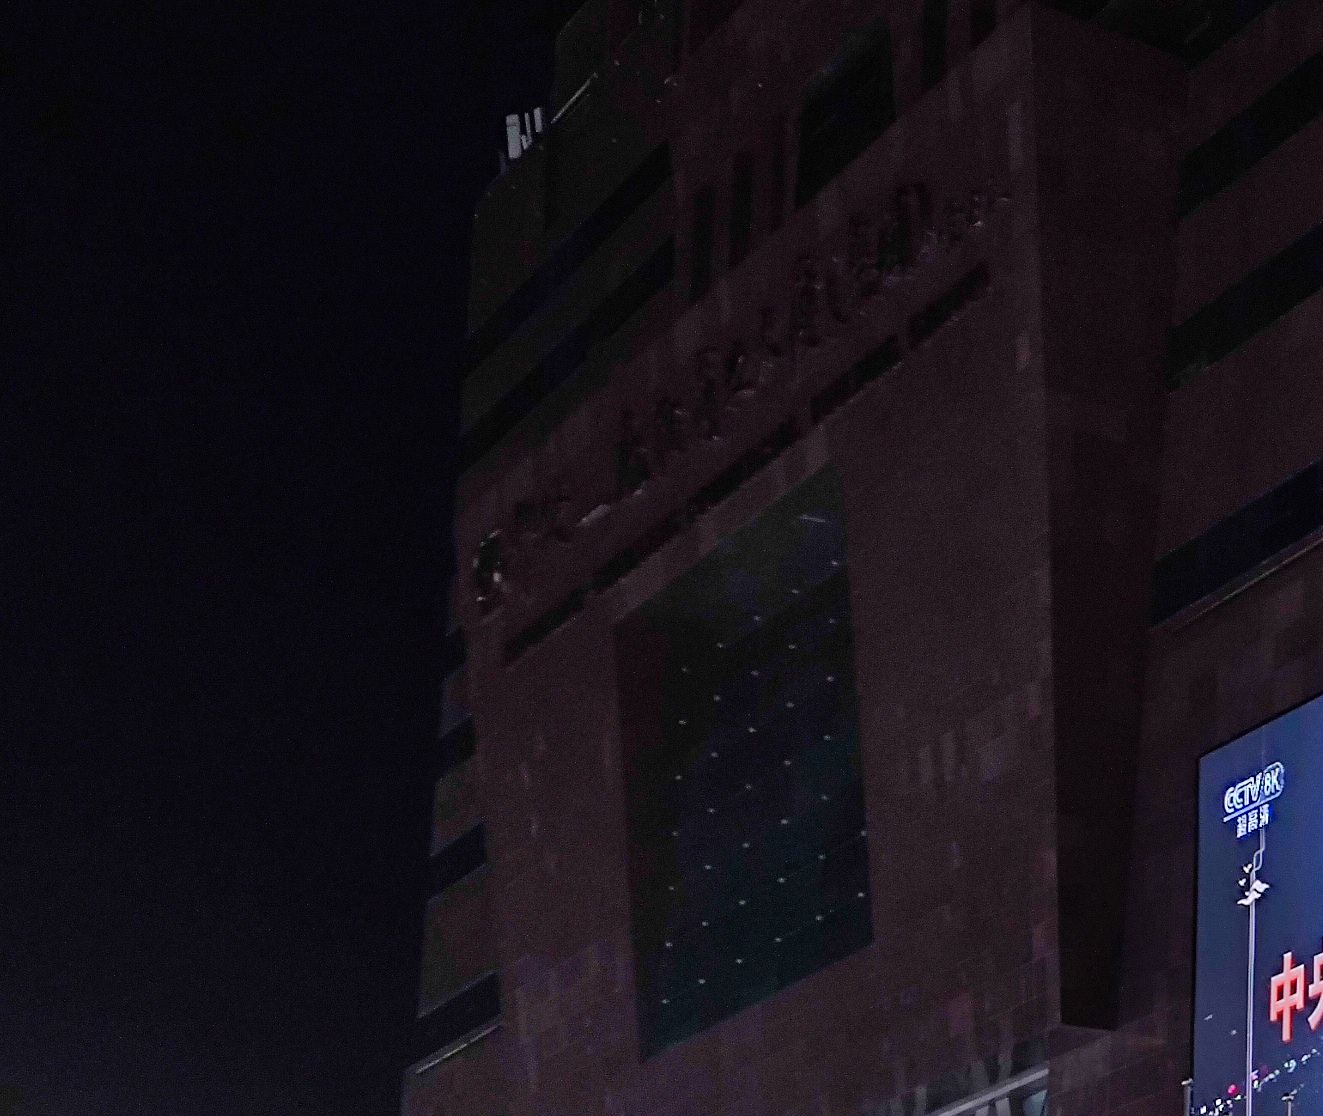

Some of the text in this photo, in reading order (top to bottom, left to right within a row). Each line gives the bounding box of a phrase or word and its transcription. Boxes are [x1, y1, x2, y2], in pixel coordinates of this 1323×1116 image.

[1224, 767, 1282, 814] CCTV 8K
[1236, 803, 1270, 838] 超高清
